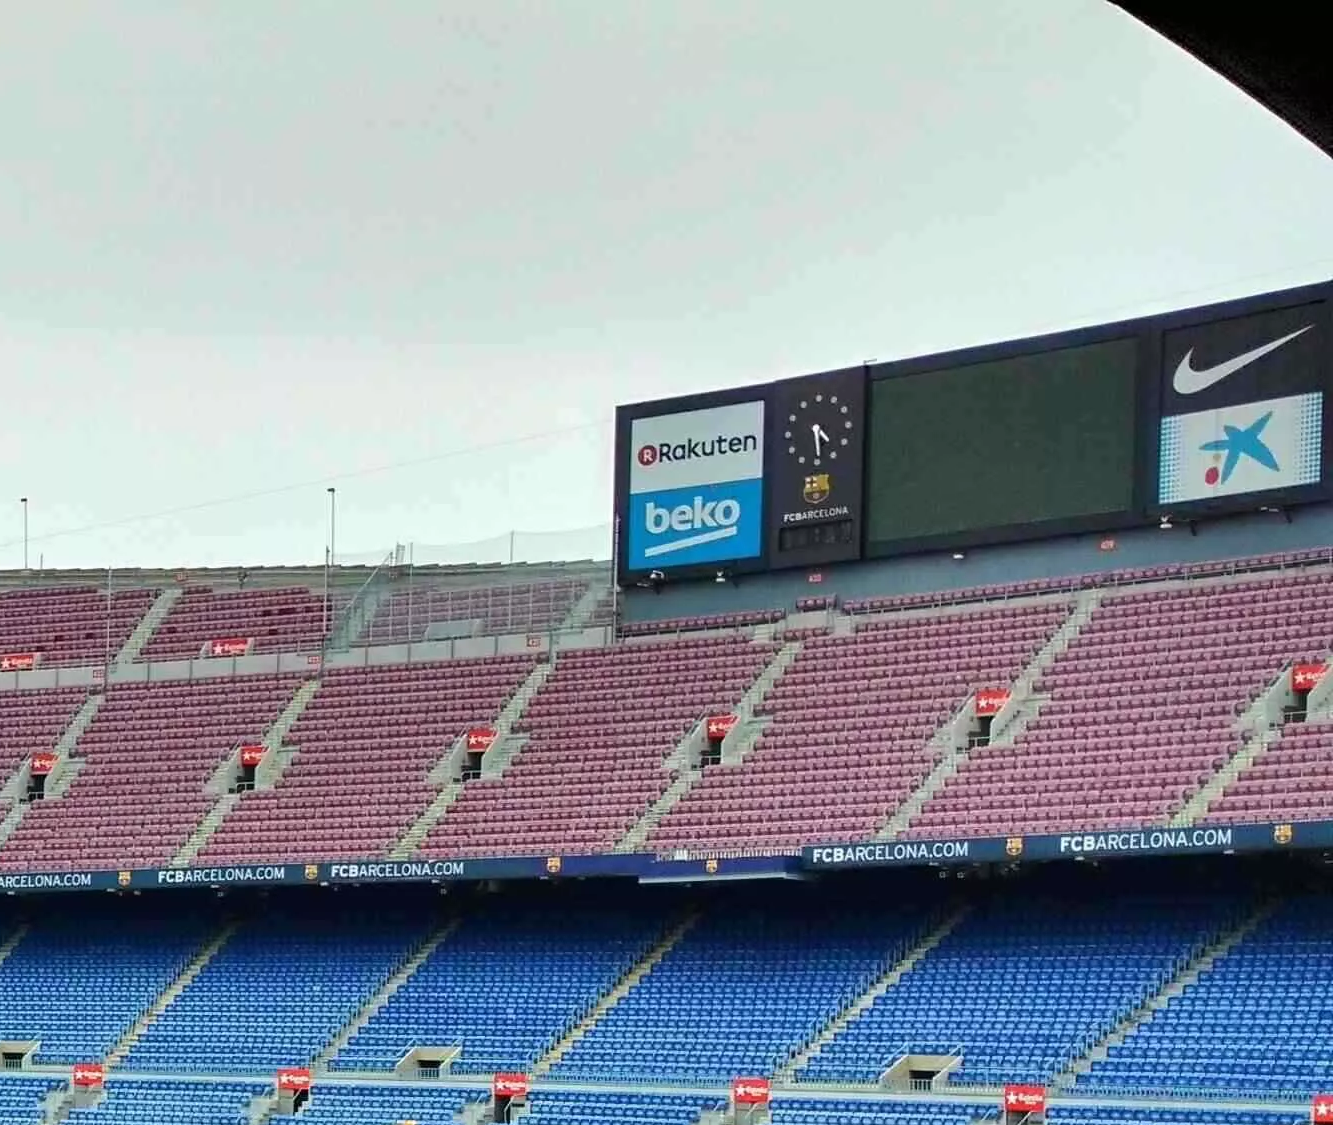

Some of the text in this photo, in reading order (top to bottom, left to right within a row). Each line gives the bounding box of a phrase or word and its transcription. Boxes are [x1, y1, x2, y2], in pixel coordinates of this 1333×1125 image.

[659, 434, 757, 463] Rakuten
[645, 496, 740, 534] beko
[783, 505, 850, 523] FCBARCELONA
[1060, 829, 1232, 853] FCBARCELONA.COM
[812, 843, 970, 863] FCBARCELONA.COM
[157, 866, 285, 884] FCBARCELONA.COM
[331, 862, 464, 878] FCBARCELONA.COM
